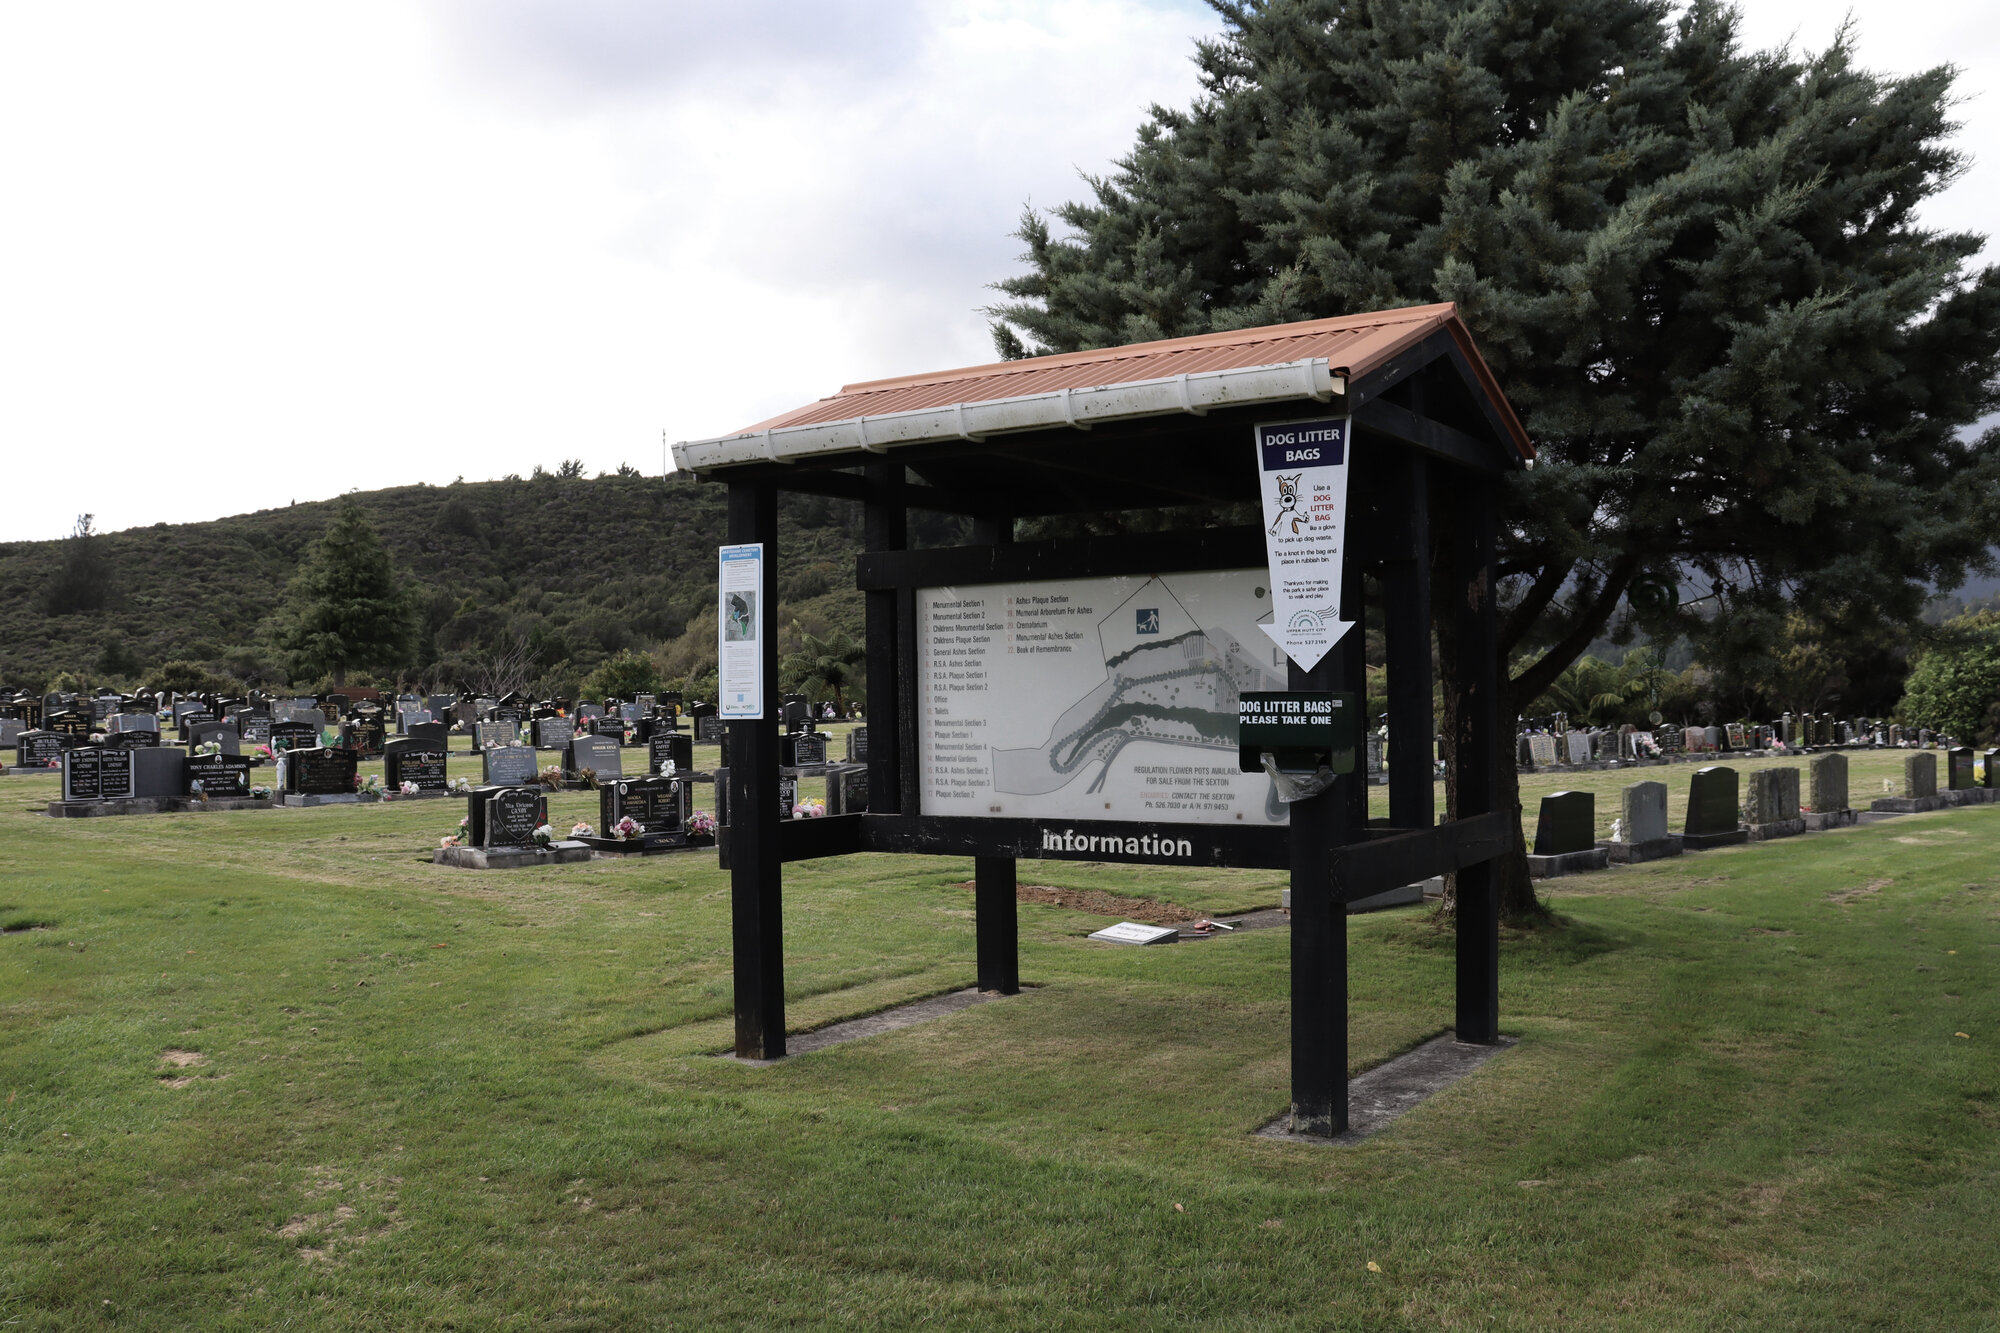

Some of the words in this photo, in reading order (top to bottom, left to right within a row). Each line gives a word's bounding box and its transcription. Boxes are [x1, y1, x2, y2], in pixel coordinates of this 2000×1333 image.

[1266, 433, 1294, 446] DOG
[1299, 429, 1339, 443] LITTER
[1286, 448, 1320, 462] BAGS
[1032, 597, 1049, 605] Plaque
[956, 636, 971, 644] Plaque
[1240, 701, 1260, 712] DOG
[1265, 701, 1300, 712] LITTER
[1304, 701, 1331, 713] BAGS
[1282, 716, 1307, 724] TAKE
[1311, 716, 1331, 724] ONE
[951, 779, 966, 787] Plaque
[1042, 828, 1191, 857] information
